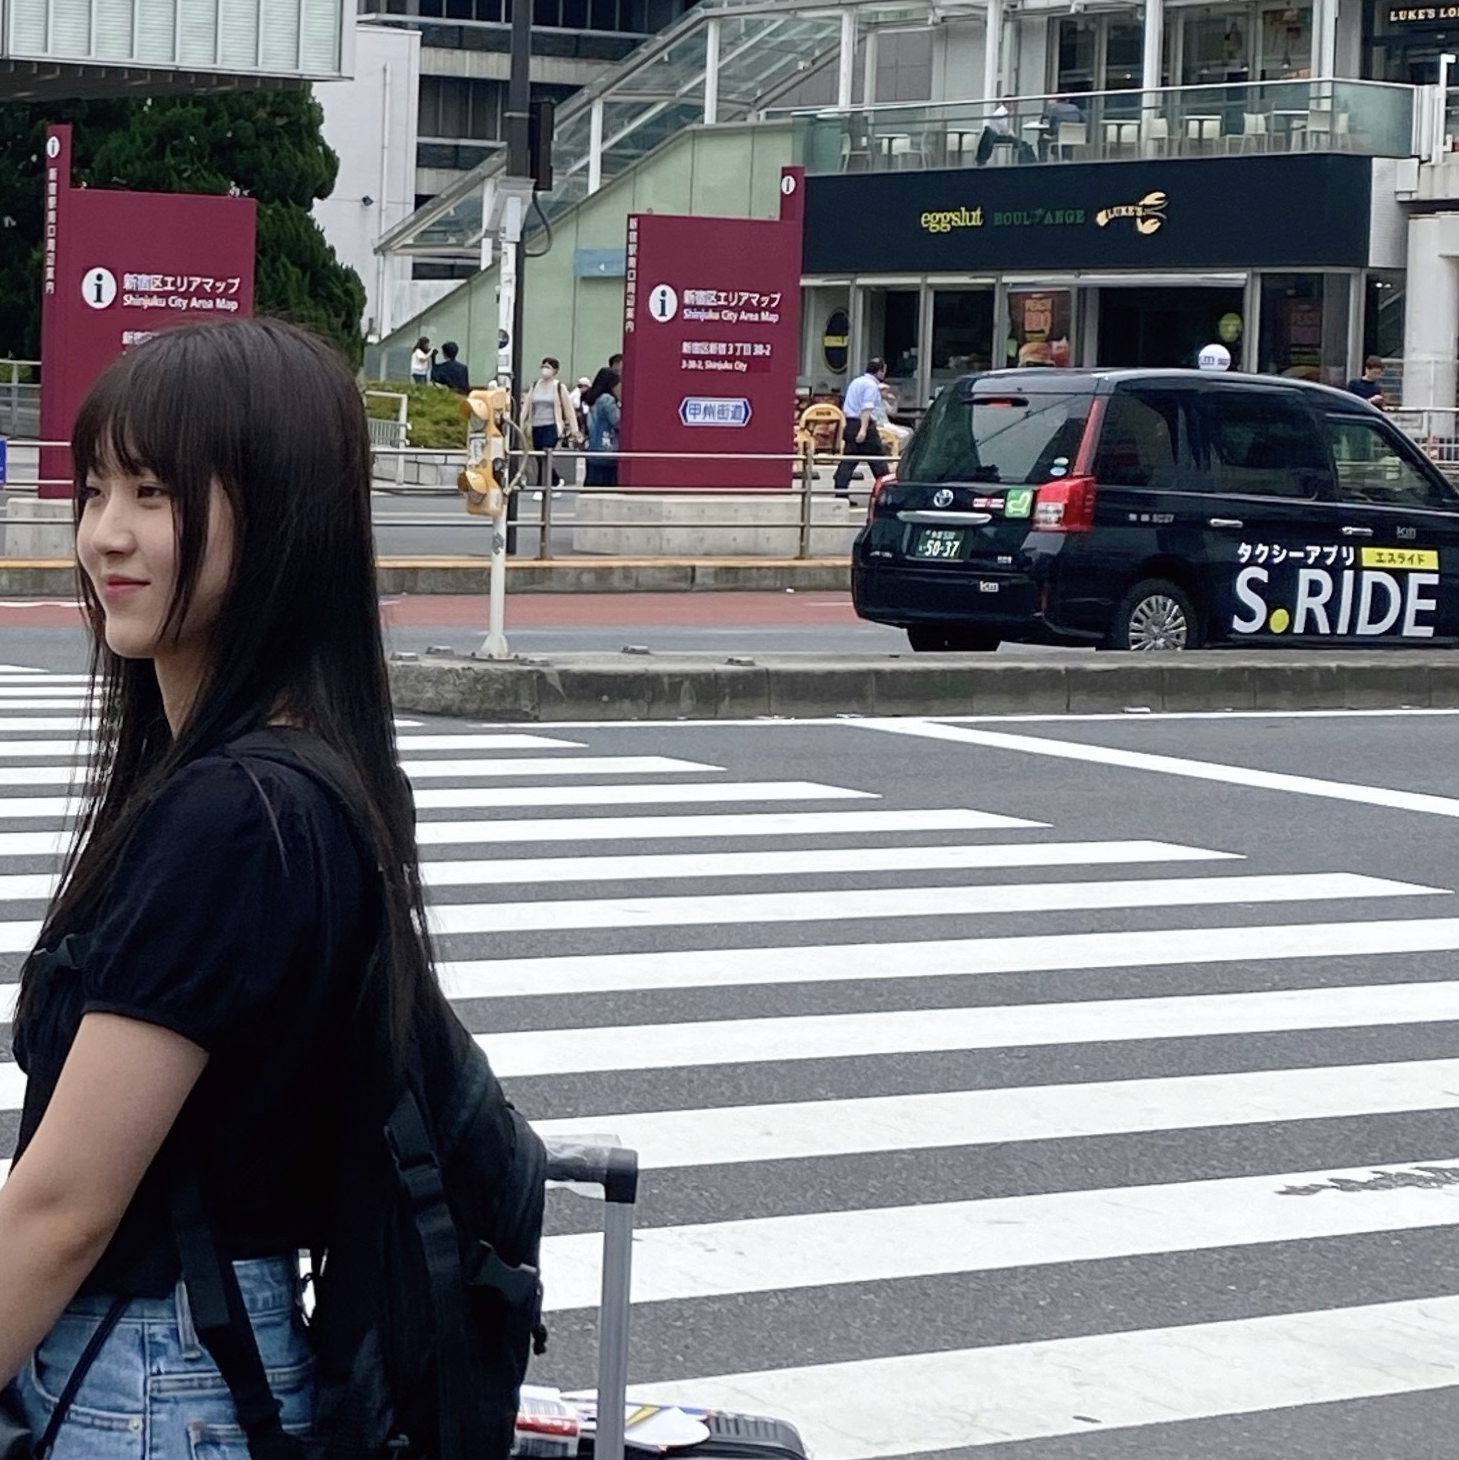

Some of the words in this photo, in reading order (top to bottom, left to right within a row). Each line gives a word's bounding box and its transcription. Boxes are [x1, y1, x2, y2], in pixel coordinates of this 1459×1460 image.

[1389, 8, 1436, 22] LUKE'S
[1439, 6, 1459, 18] LO
[920, 206, 984, 233] eggslut
[122, 272, 240, 293] 新宿区エリアマップ
[122, 294, 167, 310] Shinjuku
[167, 296, 187, 310] City
[190, 298, 214, 310] Area
[215, 298, 239, 312] Map
[683, 289, 782, 308] 新宿区エリアマップ
[683, 308, 720, 322] Shinjuku
[721, 309, 738, 323] City
[739, 311, 759, 322] Area
[760, 311, 779, 323] Map
[688, 402, 744, 421] 甲州街道
[1236, 541, 1356, 567] タクシーアプリ
[1374, 552, 1426, 565] エスライド
[1231, 565, 1440, 638] S.RIDE
